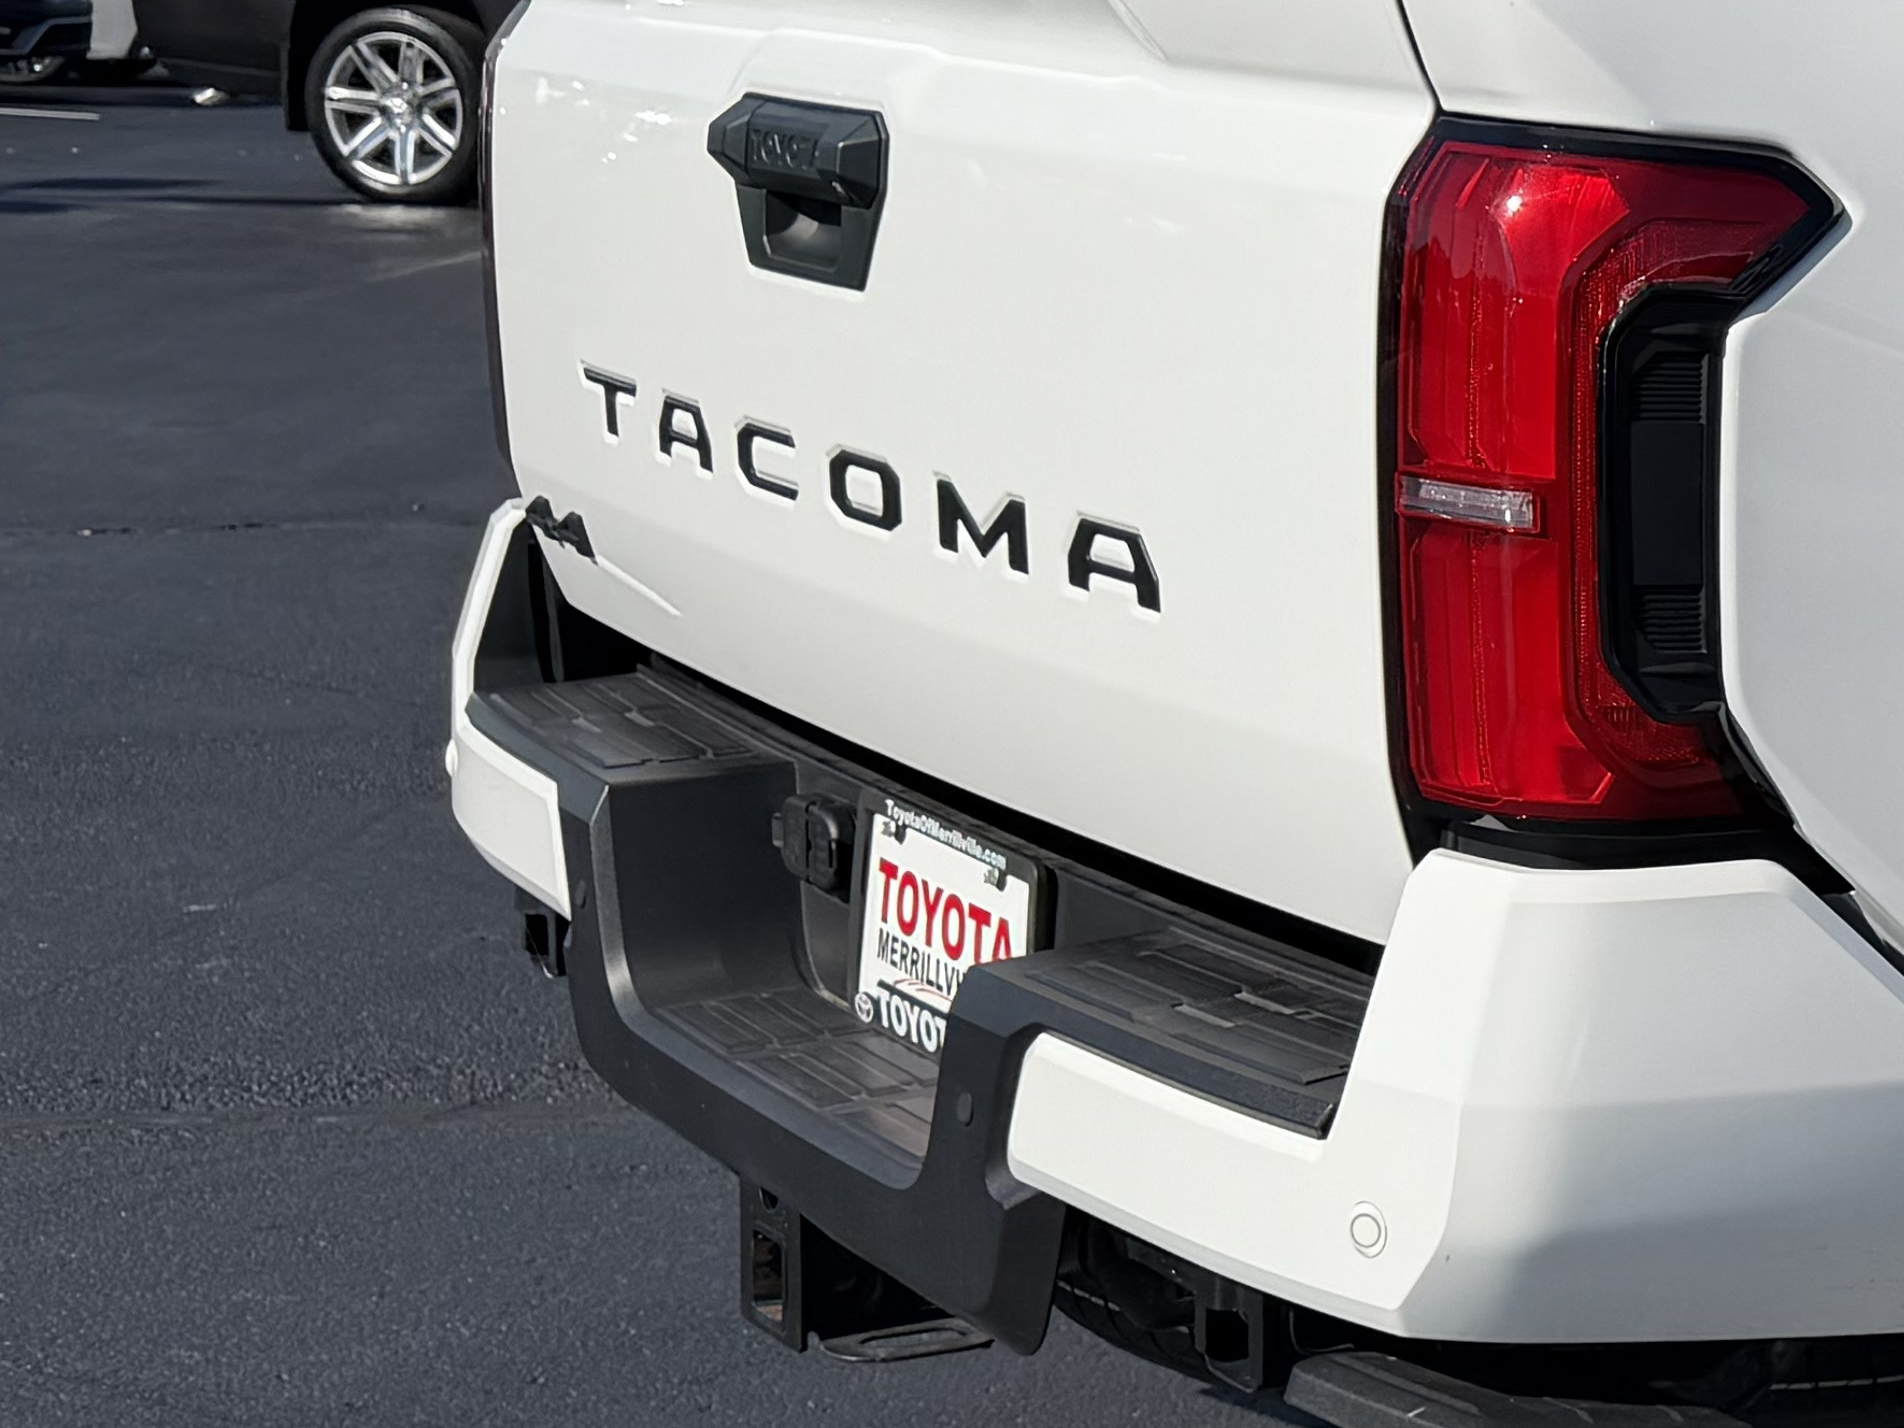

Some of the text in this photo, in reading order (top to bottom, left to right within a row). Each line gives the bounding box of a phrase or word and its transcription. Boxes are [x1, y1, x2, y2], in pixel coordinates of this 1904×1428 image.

[580, 360, 1162, 615] TACOMA
[879, 857, 1012, 965] TOYOTA
[879, 988, 947, 1053] TOYOT
